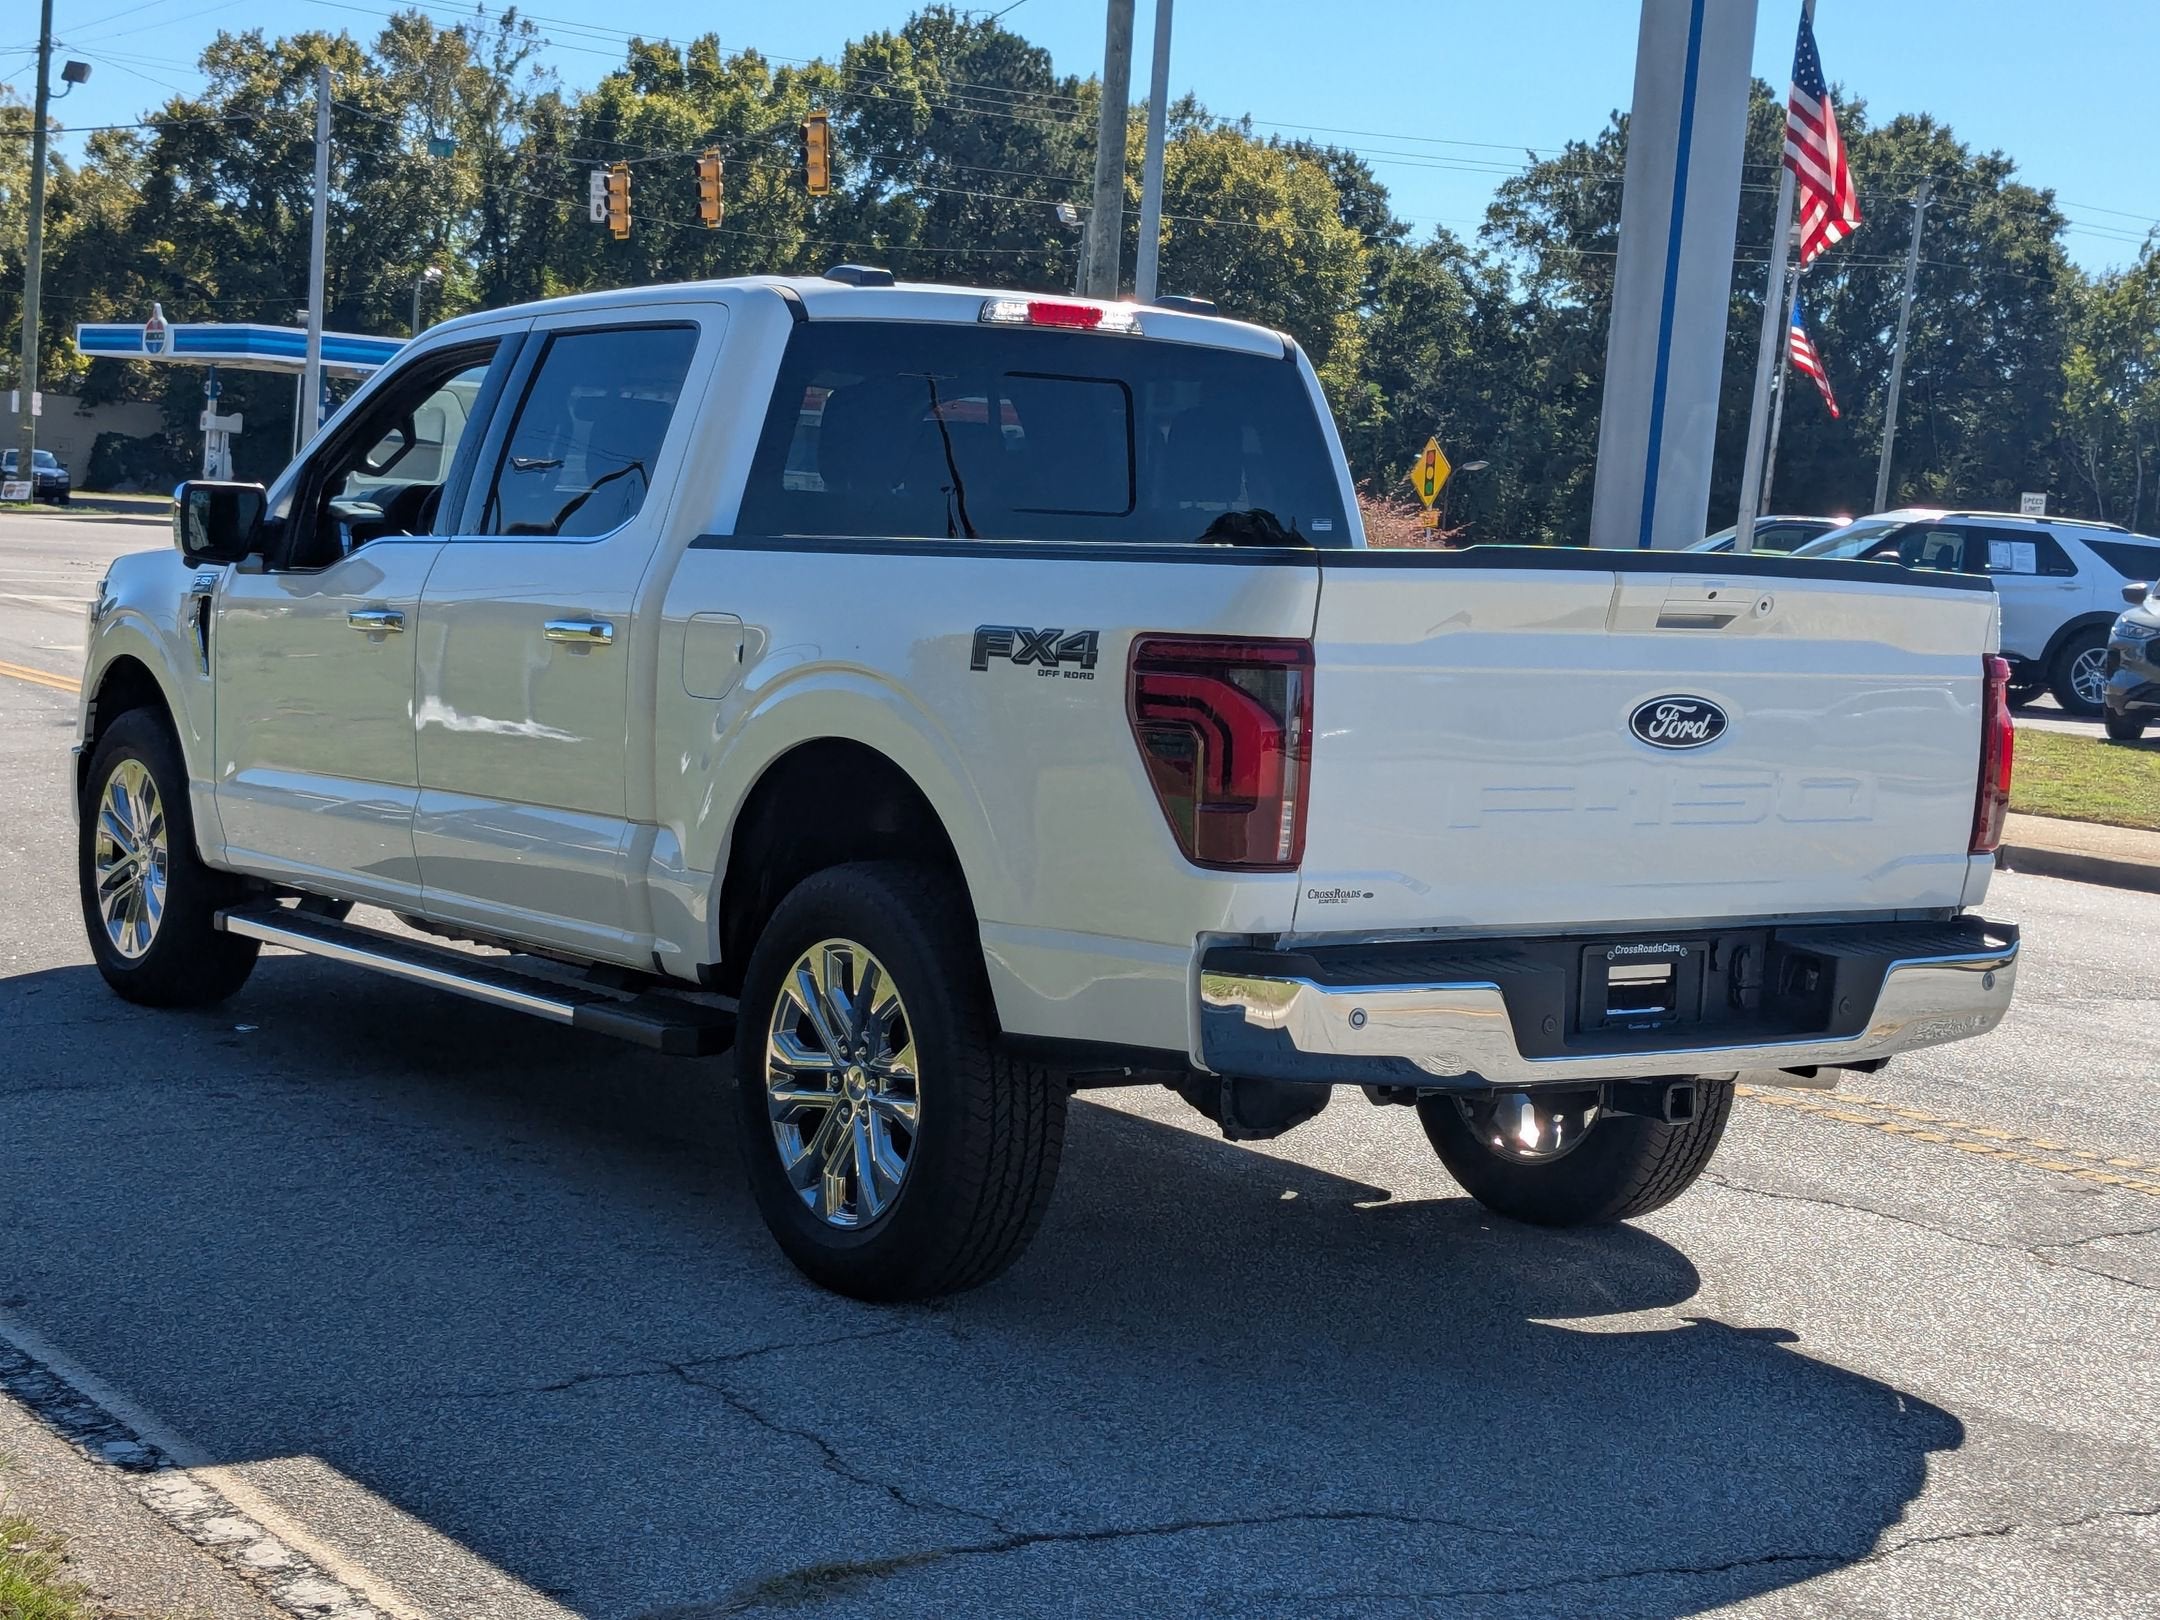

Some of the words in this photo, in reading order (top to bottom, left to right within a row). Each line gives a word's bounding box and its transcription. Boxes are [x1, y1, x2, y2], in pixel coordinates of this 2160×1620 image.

[970, 624, 1100, 672] FX4
[1037, 669, 1060, 678] OFF
[1063, 671, 1095, 680] ROAD
[1648, 703, 1712, 739] Ford
[1615, 943, 1680, 955] CrossRoadsCars
